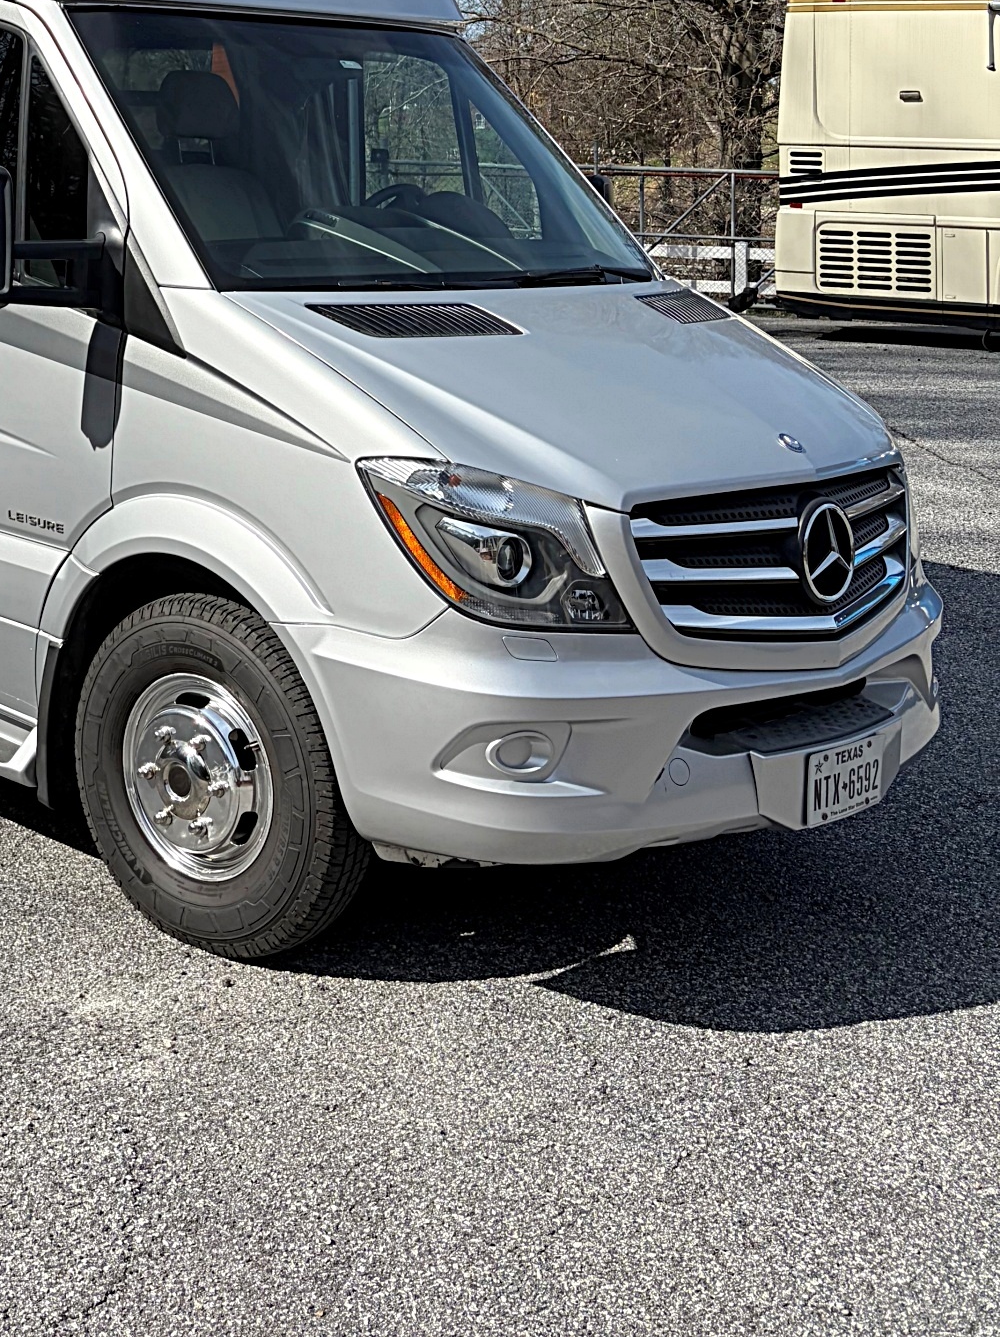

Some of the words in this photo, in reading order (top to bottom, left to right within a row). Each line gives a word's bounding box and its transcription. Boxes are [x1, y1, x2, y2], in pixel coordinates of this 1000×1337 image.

[8, 510, 64, 534] LEISURE
[835, 745, 863, 765] TEXAS
[99, 780, 137, 862] MICHELIN
